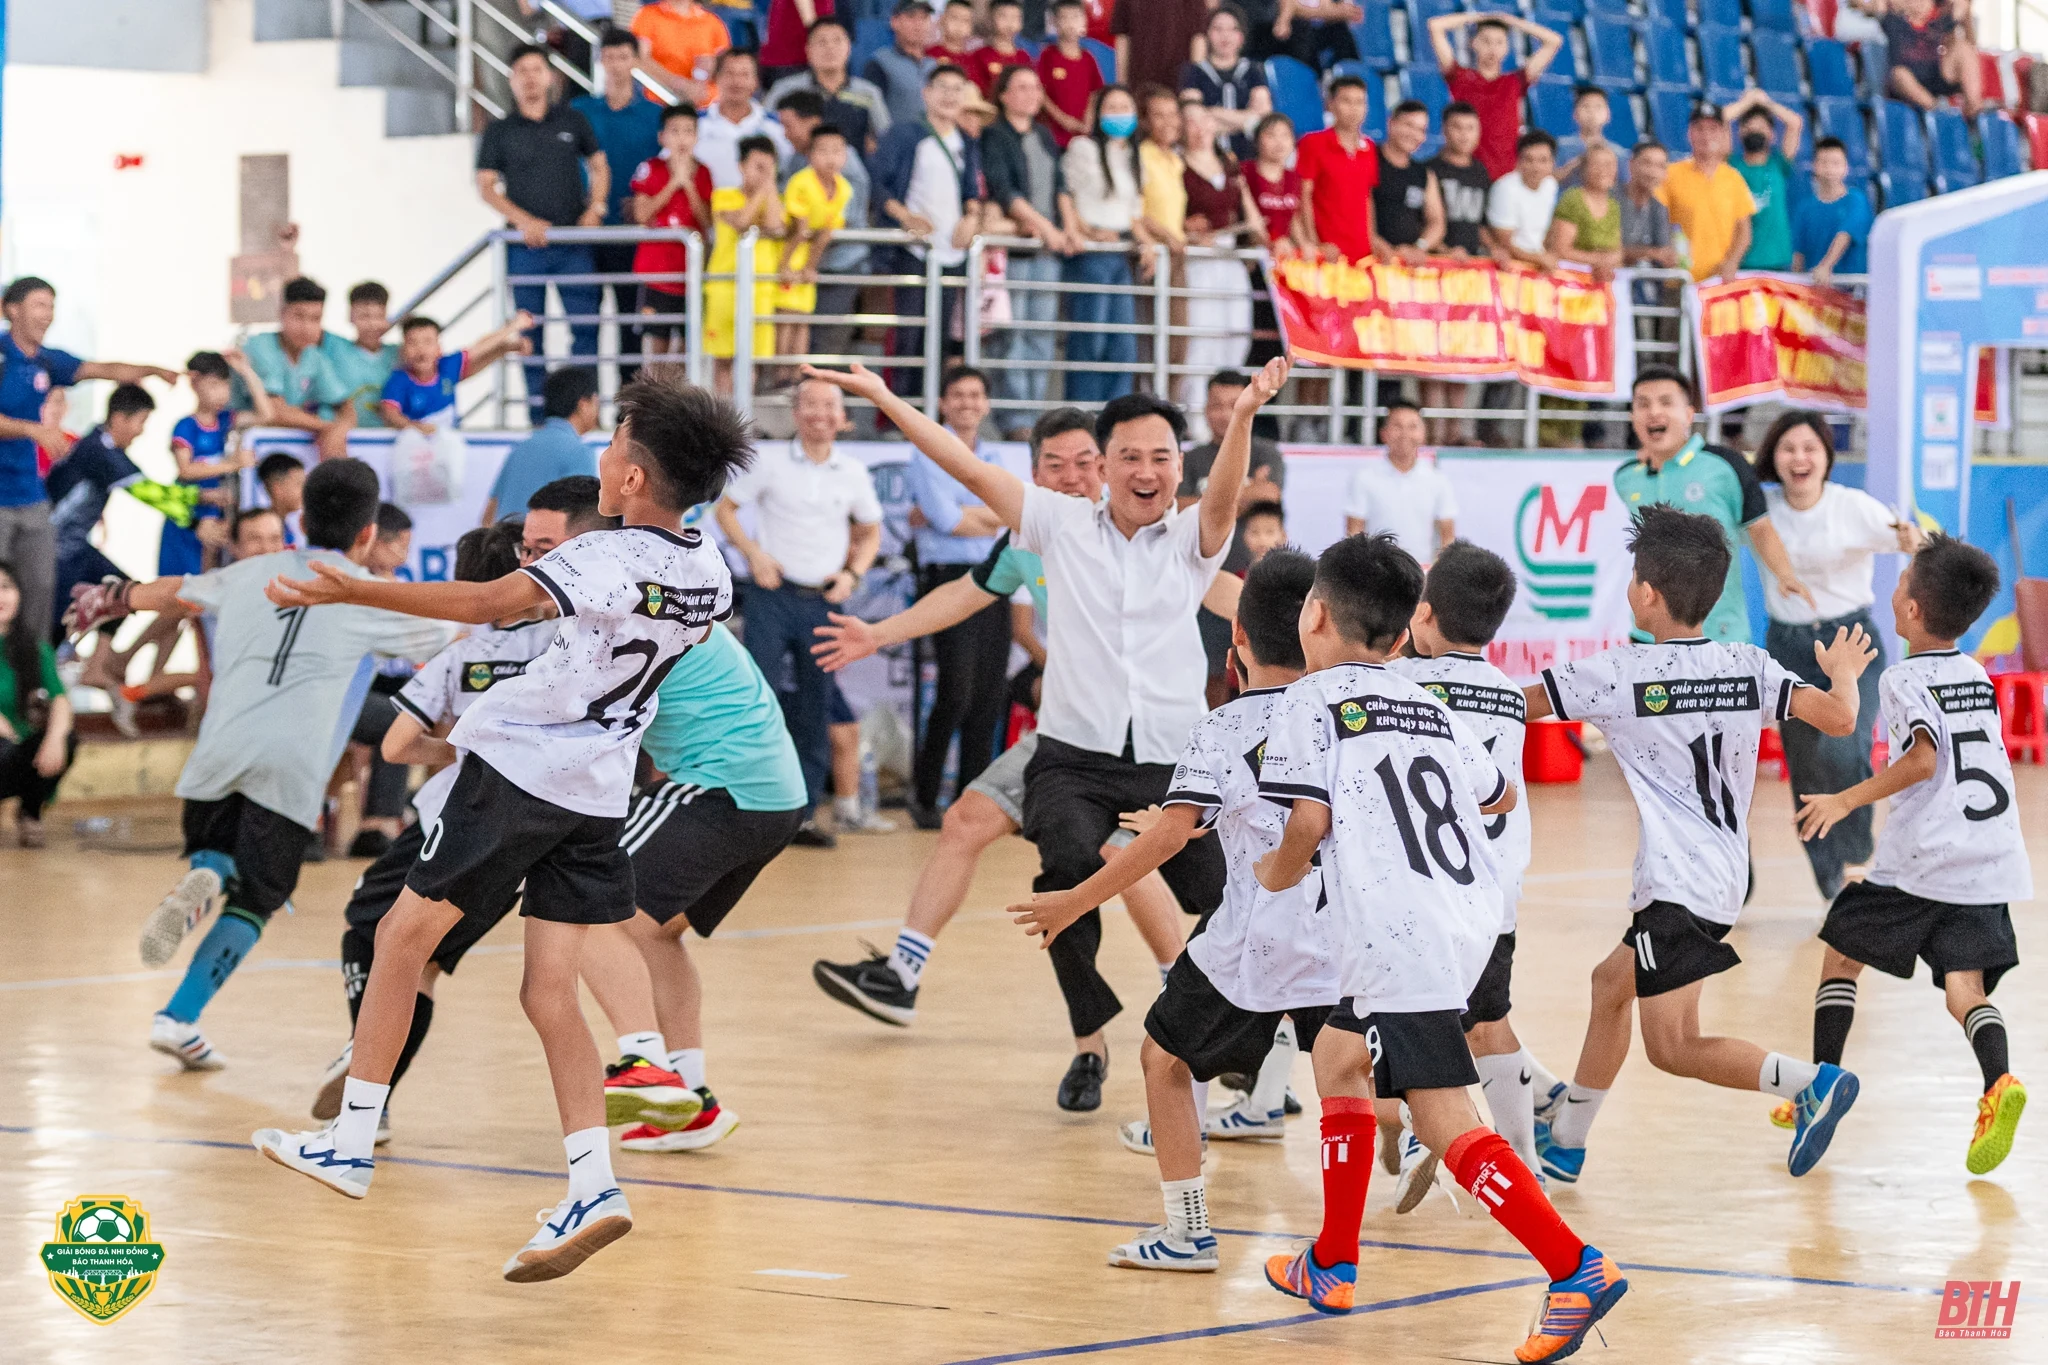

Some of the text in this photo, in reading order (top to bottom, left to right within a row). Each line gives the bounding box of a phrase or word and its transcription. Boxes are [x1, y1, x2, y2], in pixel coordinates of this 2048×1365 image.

[1449, 685, 1474, 697] CHẮP
[1475, 689, 1499, 700] CÁNH
[1500, 692, 1515, 703] ƯỚC
[1670, 681, 1693, 695] CHẮP
[1693, 683, 1717, 694] CÁNH
[1718, 681, 1735, 693] ƯỚC
[1365, 697, 1390, 712] CHẮP
[1391, 703, 1415, 716] CÁNH
[1416, 706, 1435, 719] ƯỚC
[1456, 698, 1479, 709] KHƠI
[1479, 701, 1497, 713] DẬY
[1497, 704, 1515, 715] ĐAM
[1675, 698, 1698, 709] KHƠI
[1715, 697, 1734, 707] ĐAM
[1399, 717, 1416, 732] DẬY
[1418, 720, 1440, 732] ĐAM
[1688, 732, 1738, 835] 11
[1951, 729, 2010, 822] 5
[1373, 753, 1476, 886] 18
[1635, 930, 1657, 972] 11
